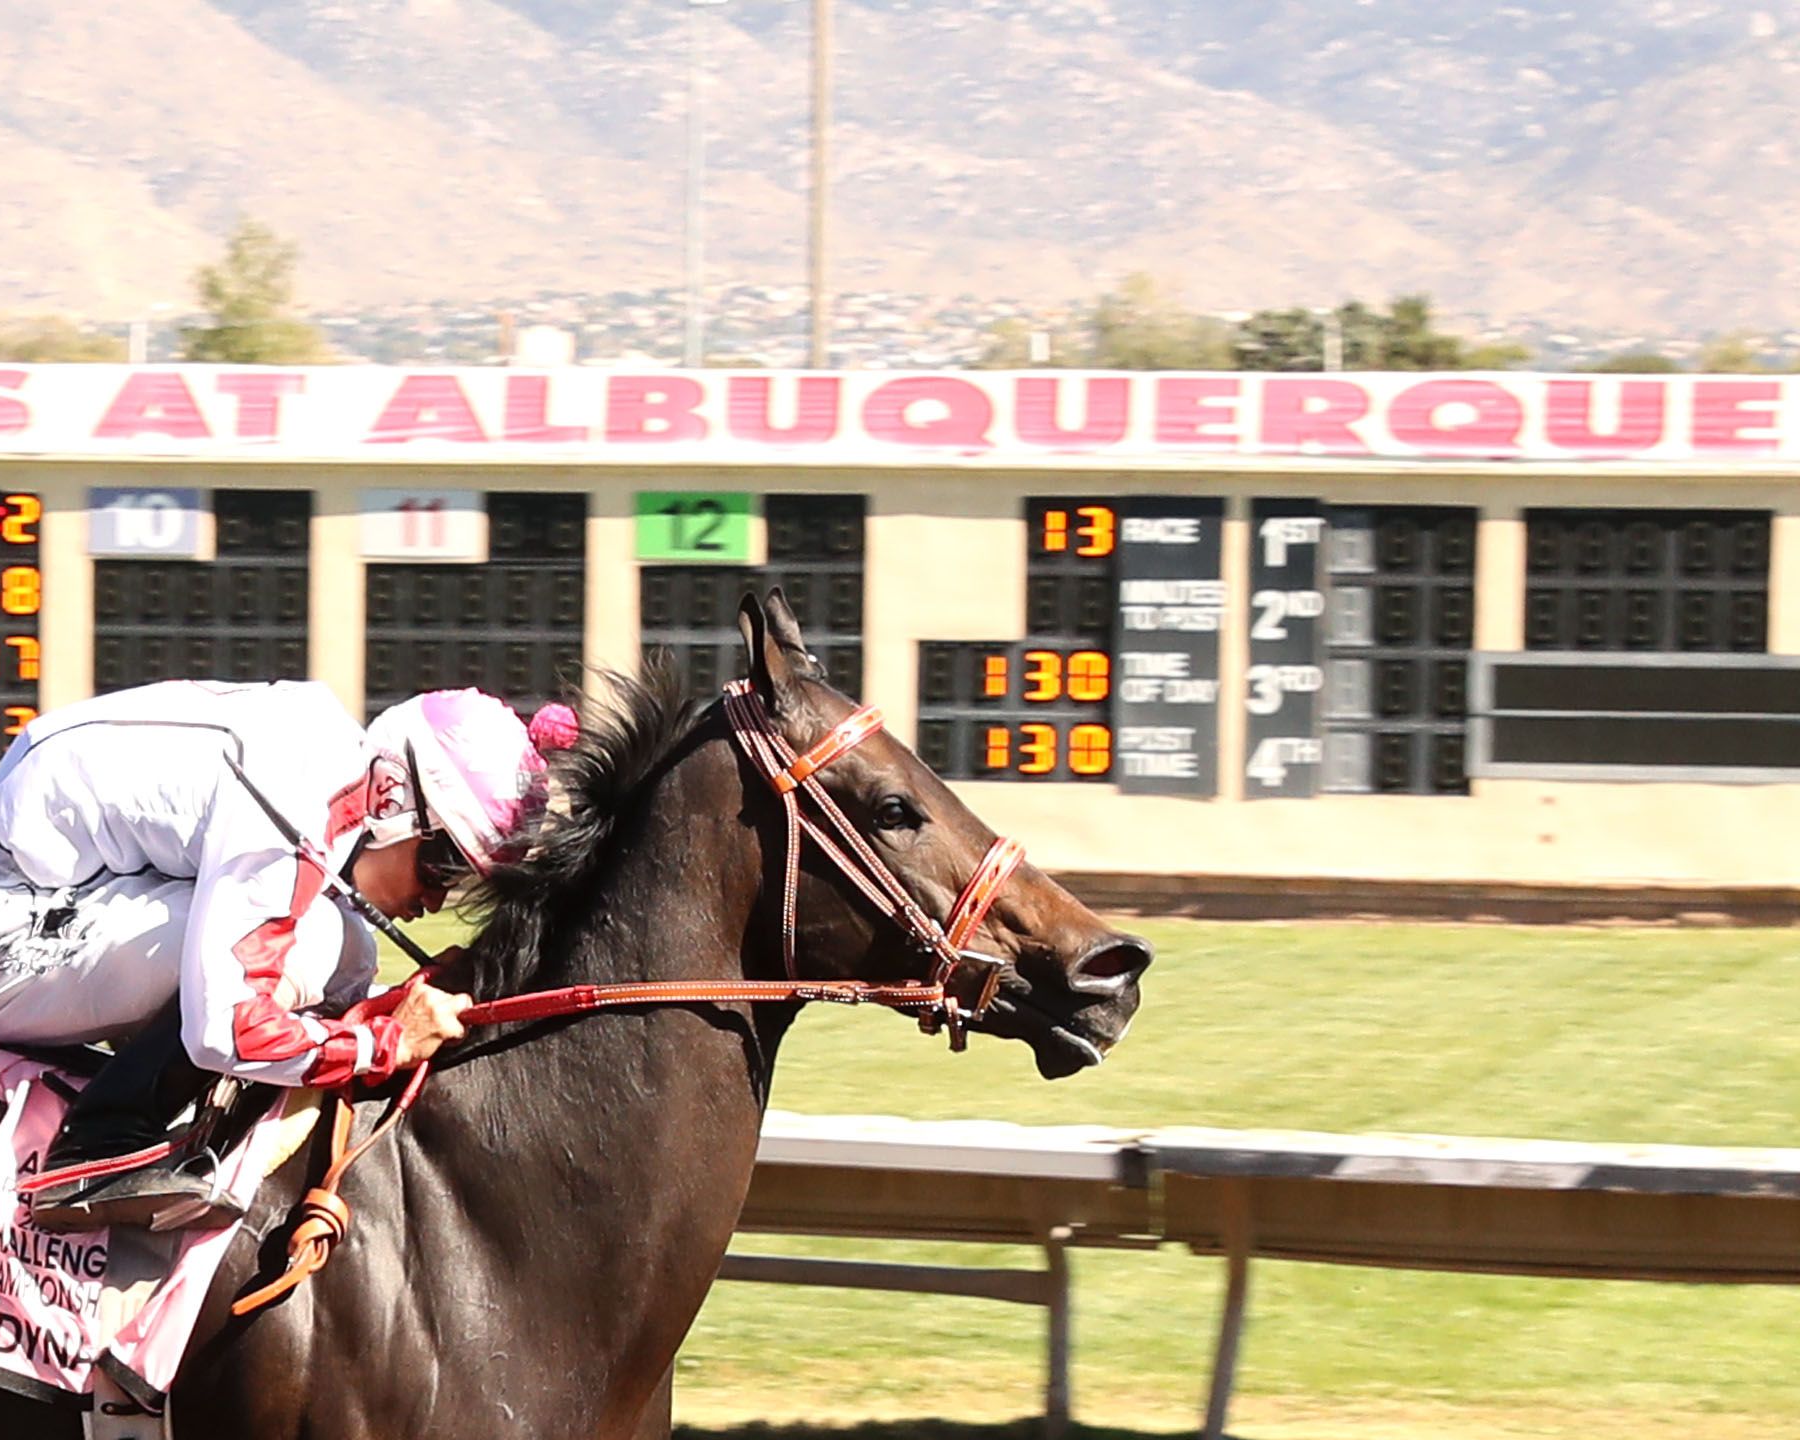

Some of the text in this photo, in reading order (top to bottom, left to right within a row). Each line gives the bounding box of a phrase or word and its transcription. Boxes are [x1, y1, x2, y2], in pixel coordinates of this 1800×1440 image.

[91, 371, 307, 440] AT
[361, 374, 1782, 457] ALBUQUERQUE
[114, 493, 184, 550] 10
[393, 497, 448, 548] 11
[657, 499, 727, 552] 12
[1044, 507, 1114, 556] 13
